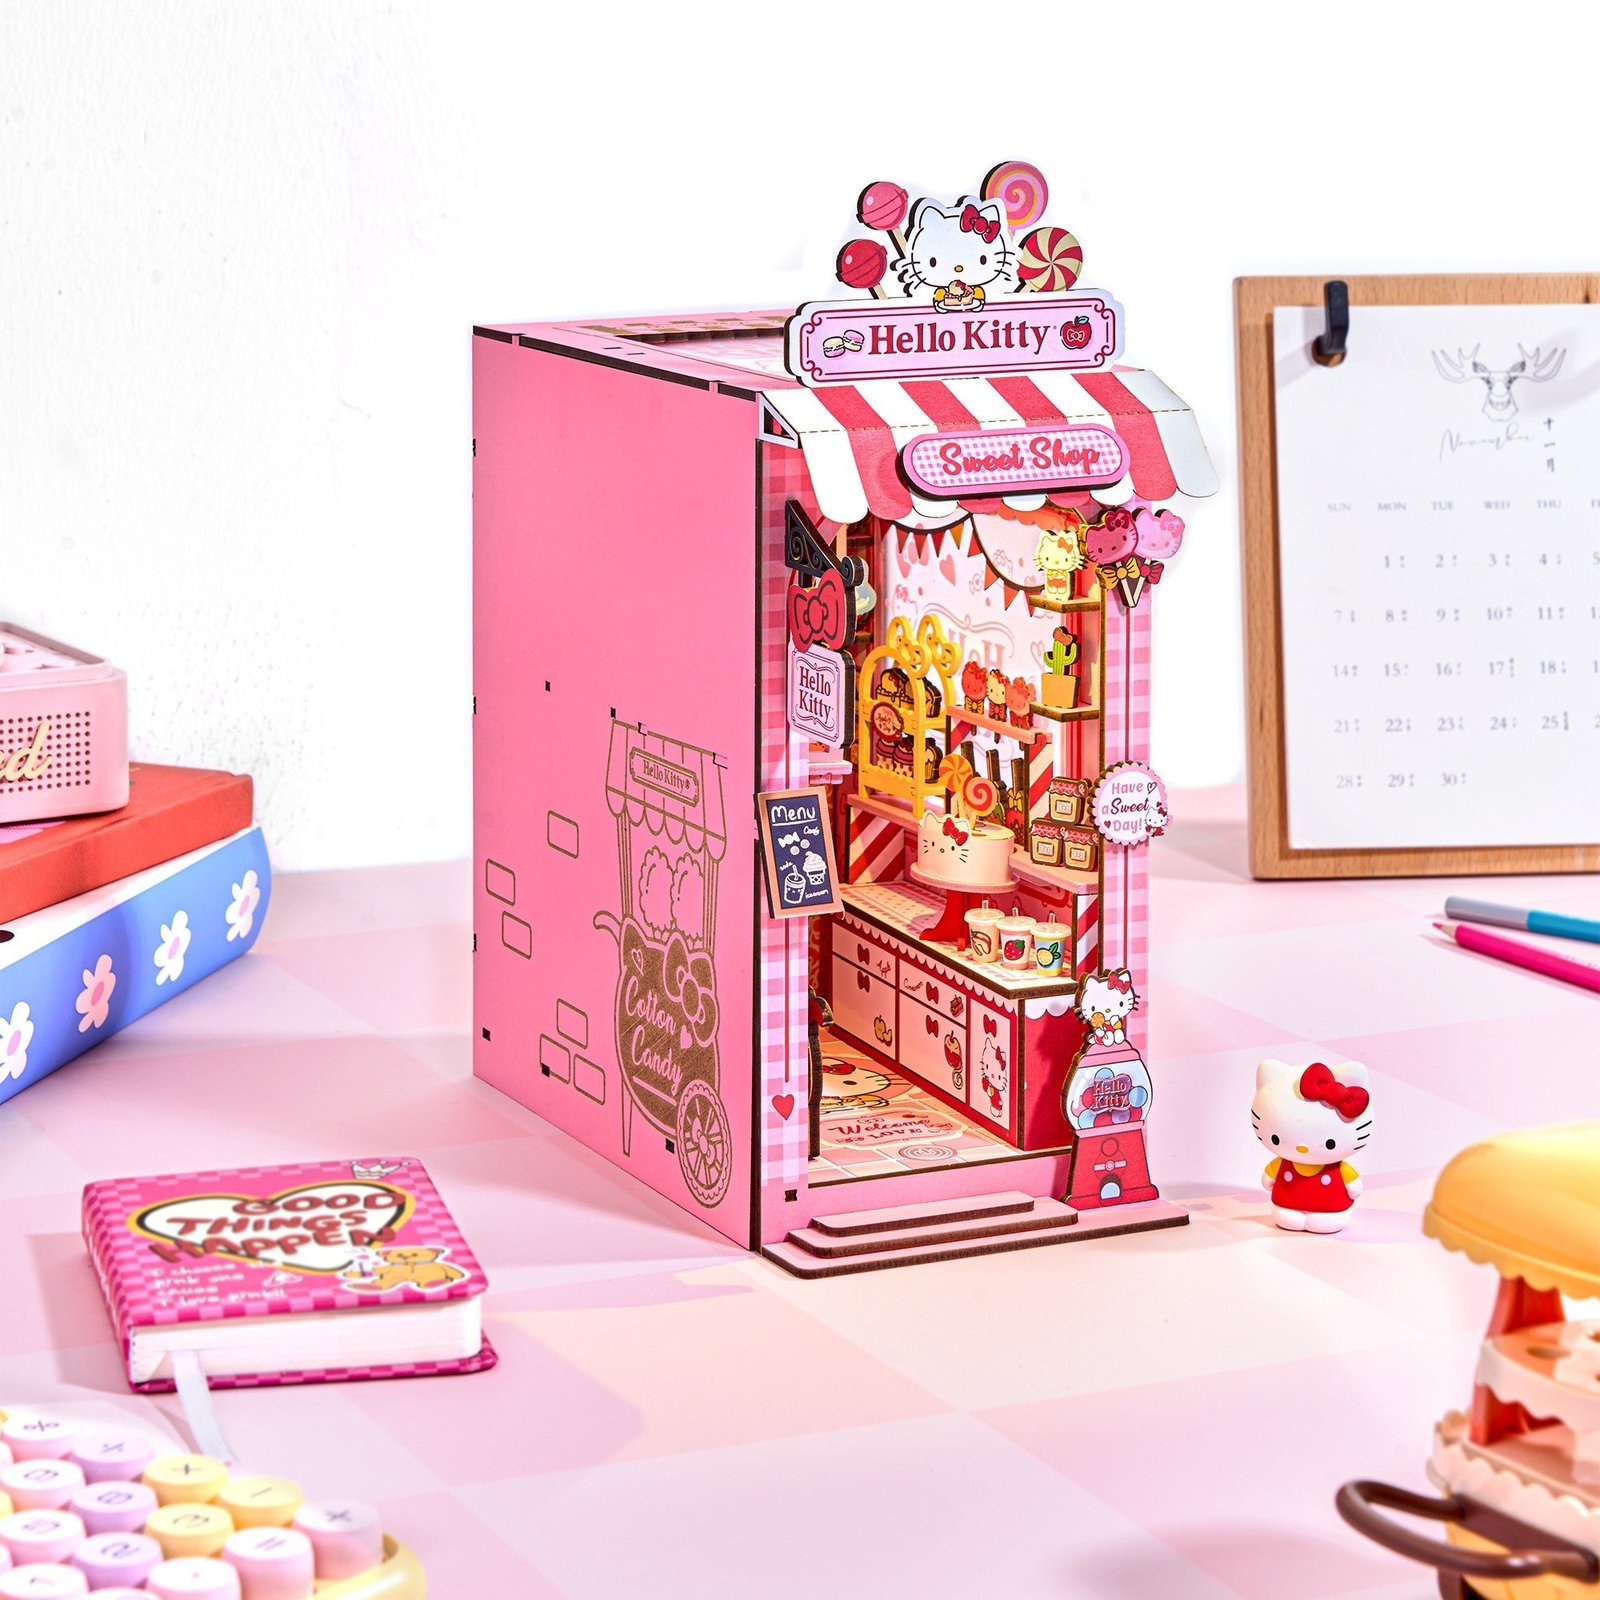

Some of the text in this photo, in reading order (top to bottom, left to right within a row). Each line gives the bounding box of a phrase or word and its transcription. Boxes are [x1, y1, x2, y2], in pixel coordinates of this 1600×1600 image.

[868, 319, 1051, 355] Hello Kitty
[939, 436, 1100, 476] Sweet Shop
[1327, 499, 1562, 512] SUN MON TUE WED THU
[1333, 664, 1349, 678] 14
[1384, 662, 1401, 678] 15
[1436, 662, 1453, 677] 16
[1488, 660, 1505, 676] 17
[1540, 660, 1557, 675] 18
[799, 665, 831, 697] Hello
[799, 688, 831, 725] Kitty
[1333, 719, 1350, 734] 21
[1385, 718, 1403, 732] 22
[1437, 716, 1455, 732] 23
[1490, 716, 1508, 731] 24
[1541, 714, 1559, 730] 25
[643, 759, 664, 782] Hello
[1335, 774, 1354, 789] 28
[1387, 773, 1406, 788] 29
[1440, 772, 1458, 787] 30
[1111, 782, 1144, 795] Have
[771, 805, 816, 823] Menu
[1101, 797, 1149, 815] a Sweet
[1112, 817, 1143, 834] Day!
[625, 975, 677, 1036] Cotton
[631, 1024, 683, 1097] Candy
[1093, 1080, 1127, 1095] Hello
[1093, 1094, 1128, 1108] Kitty
[827, 1119, 930, 1135] Welcome
[231, 1192, 407, 1216] GOOD
[166, 1210, 368, 1236] THINGS
[148, 1226, 397, 1264] HAPPEN
